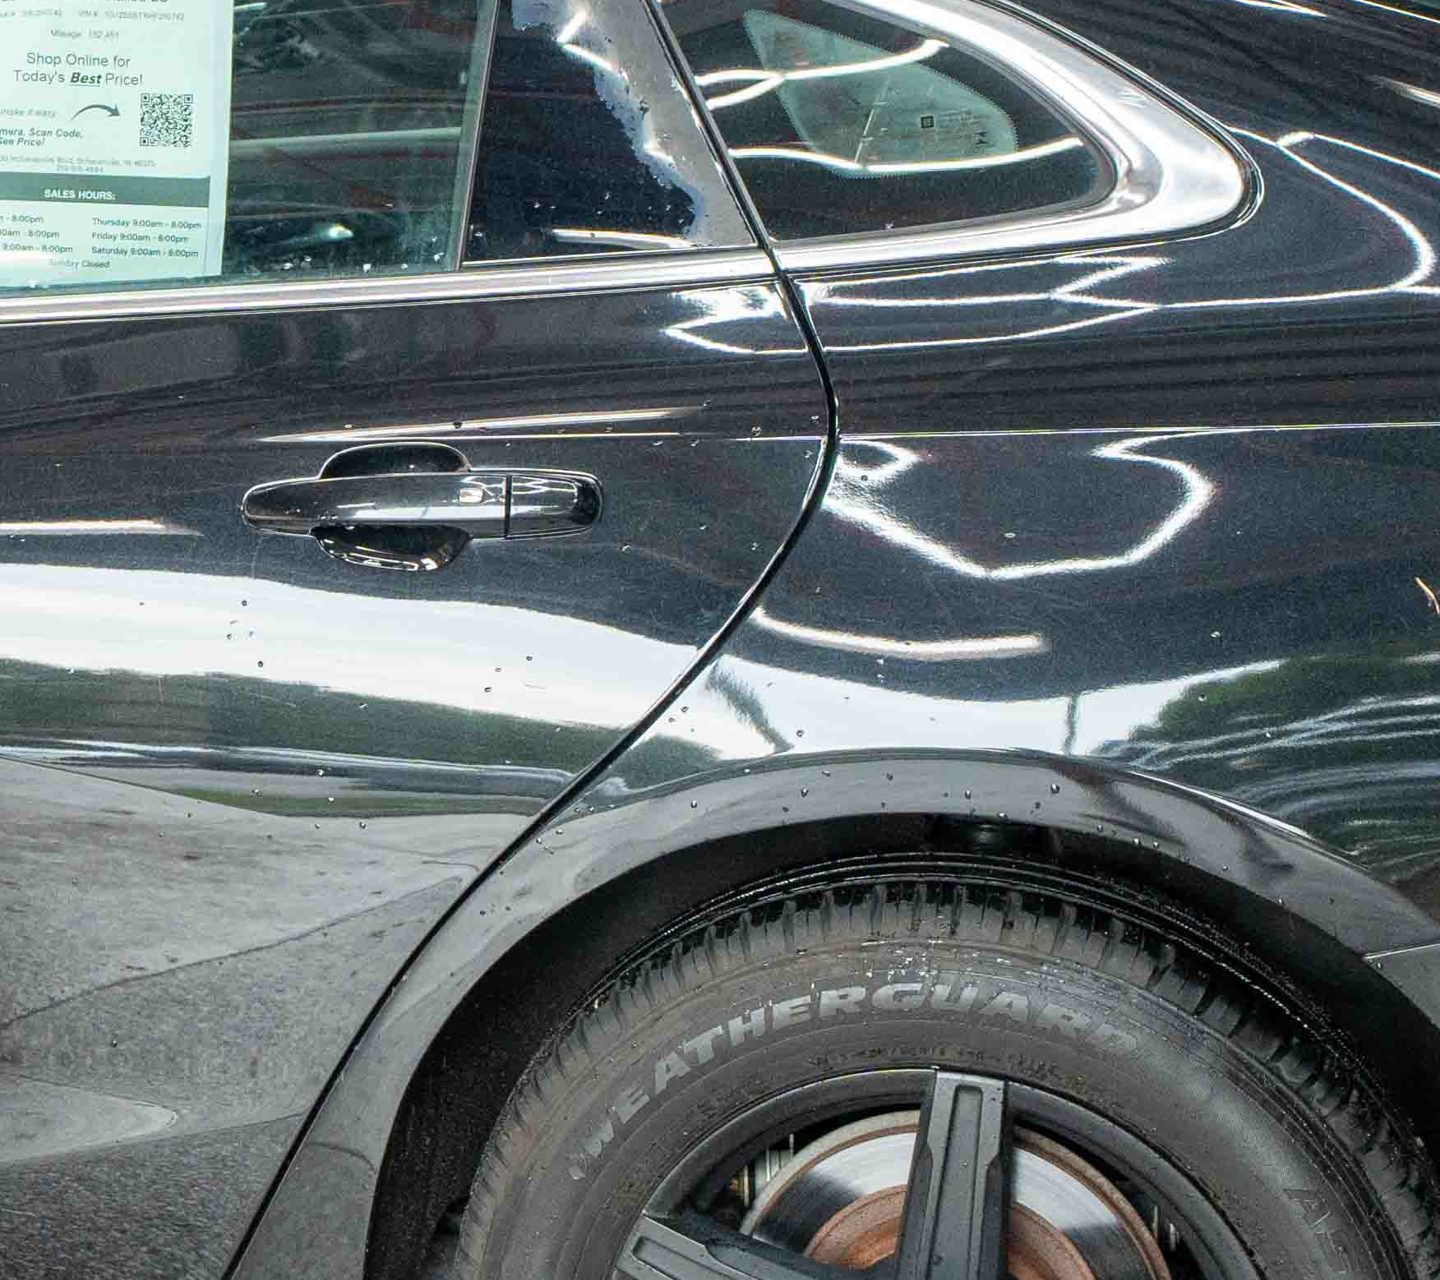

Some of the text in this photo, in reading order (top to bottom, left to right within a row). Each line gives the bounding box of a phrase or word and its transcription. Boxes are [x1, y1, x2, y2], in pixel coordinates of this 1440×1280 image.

[27, 53, 131, 67] Shop Online for
[14, 70, 143, 86] Today's Best Price!
[28, 127, 53, 137] Scan
[16, 137, 46, 146] Price!
[44, 188, 116, 200] SALES HOURS:
[92, 218, 130, 229] Thursday
[92, 232, 118, 242] Friday
[92, 246, 128, 257] Saturday
[81, 259, 110, 269] Closed
[579, 982, 1142, 1163] WEATHERGUARD
